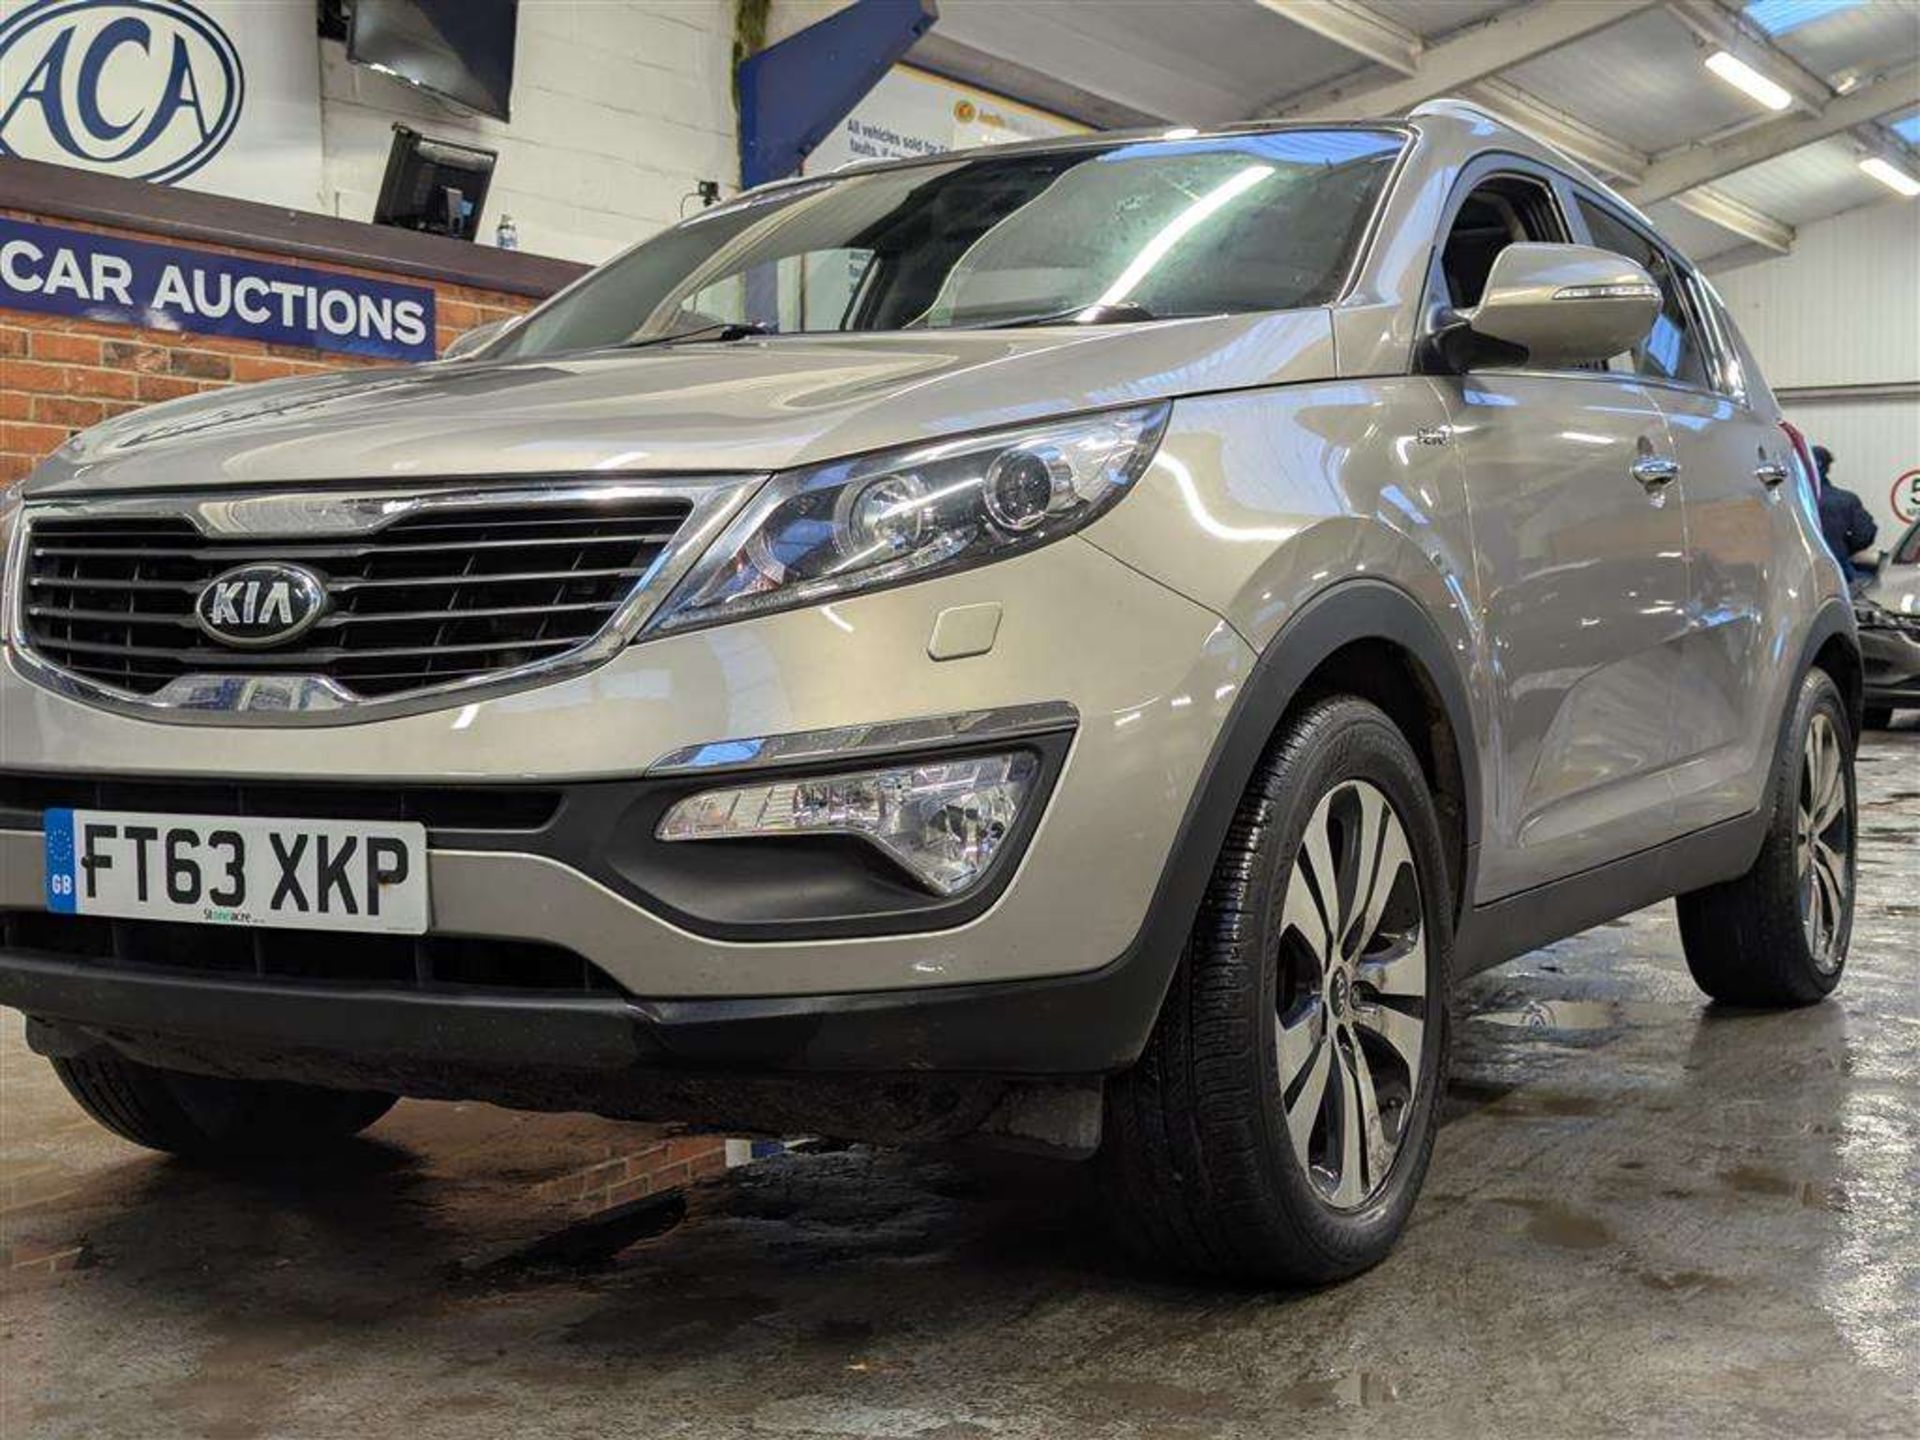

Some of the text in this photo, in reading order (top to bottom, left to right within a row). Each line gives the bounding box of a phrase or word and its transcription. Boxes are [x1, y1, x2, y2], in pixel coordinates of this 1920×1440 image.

[0, 16, 208, 163] ACA
[847, 118, 860, 134] All
[862, 126, 900, 146] vehicles
[903, 136, 921, 151] sold
[1, 240, 427, 345] CAR AUCTIONS
[211, 581, 293, 624] KIA
[52, 874, 72, 895] GB
[81, 824, 409, 916] FT63 XKP
